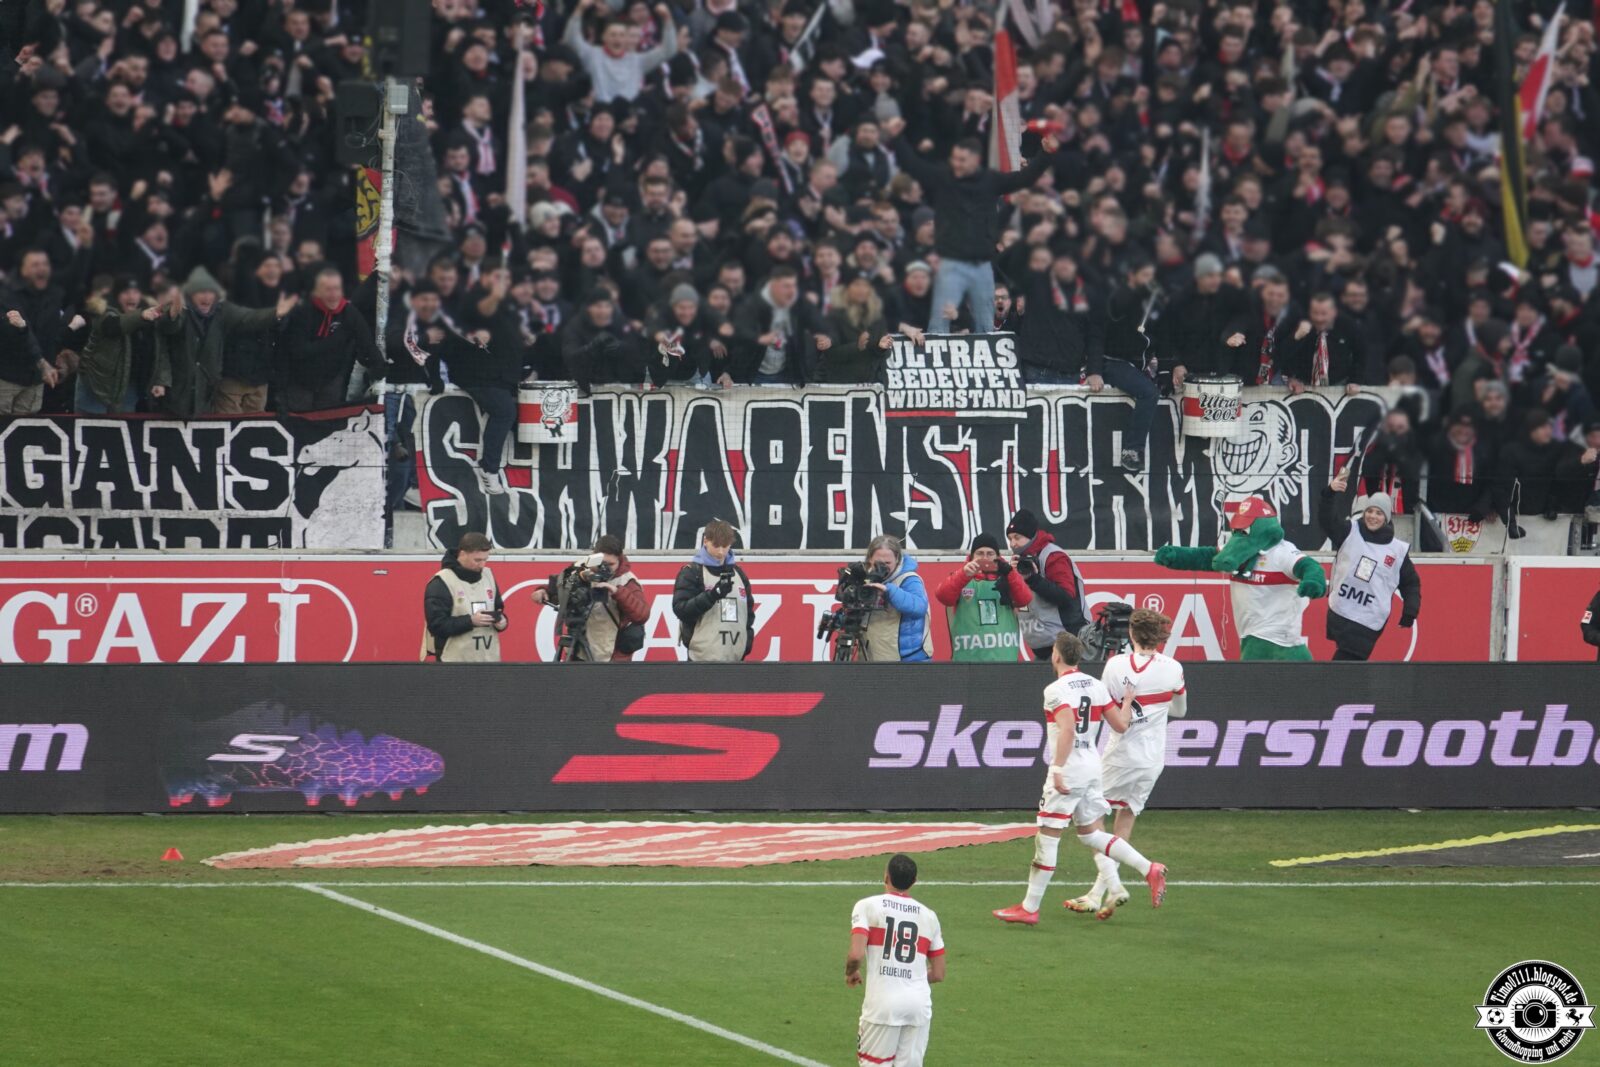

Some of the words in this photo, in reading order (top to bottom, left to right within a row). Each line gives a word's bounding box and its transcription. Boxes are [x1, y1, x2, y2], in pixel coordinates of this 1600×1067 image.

[886, 338, 1017, 368] ULTRAS
[886, 367, 1021, 389] BEDEUTET
[886, 389, 1027, 409] WIDERSTAND
[0, 418, 294, 512] GANS
[1338, 583, 1375, 606] SMF
[472, 636, 493, 650] TV
[719, 631, 740, 645] TV
[954, 632, 1018, 651] STADION
[1075, 696, 1092, 734] 9
[868, 703, 1600, 768] skeersfootb
[882, 899, 921, 915] STUTTGART
[882, 916, 919, 964] 18
[879, 965, 912, 979] LEWELING
